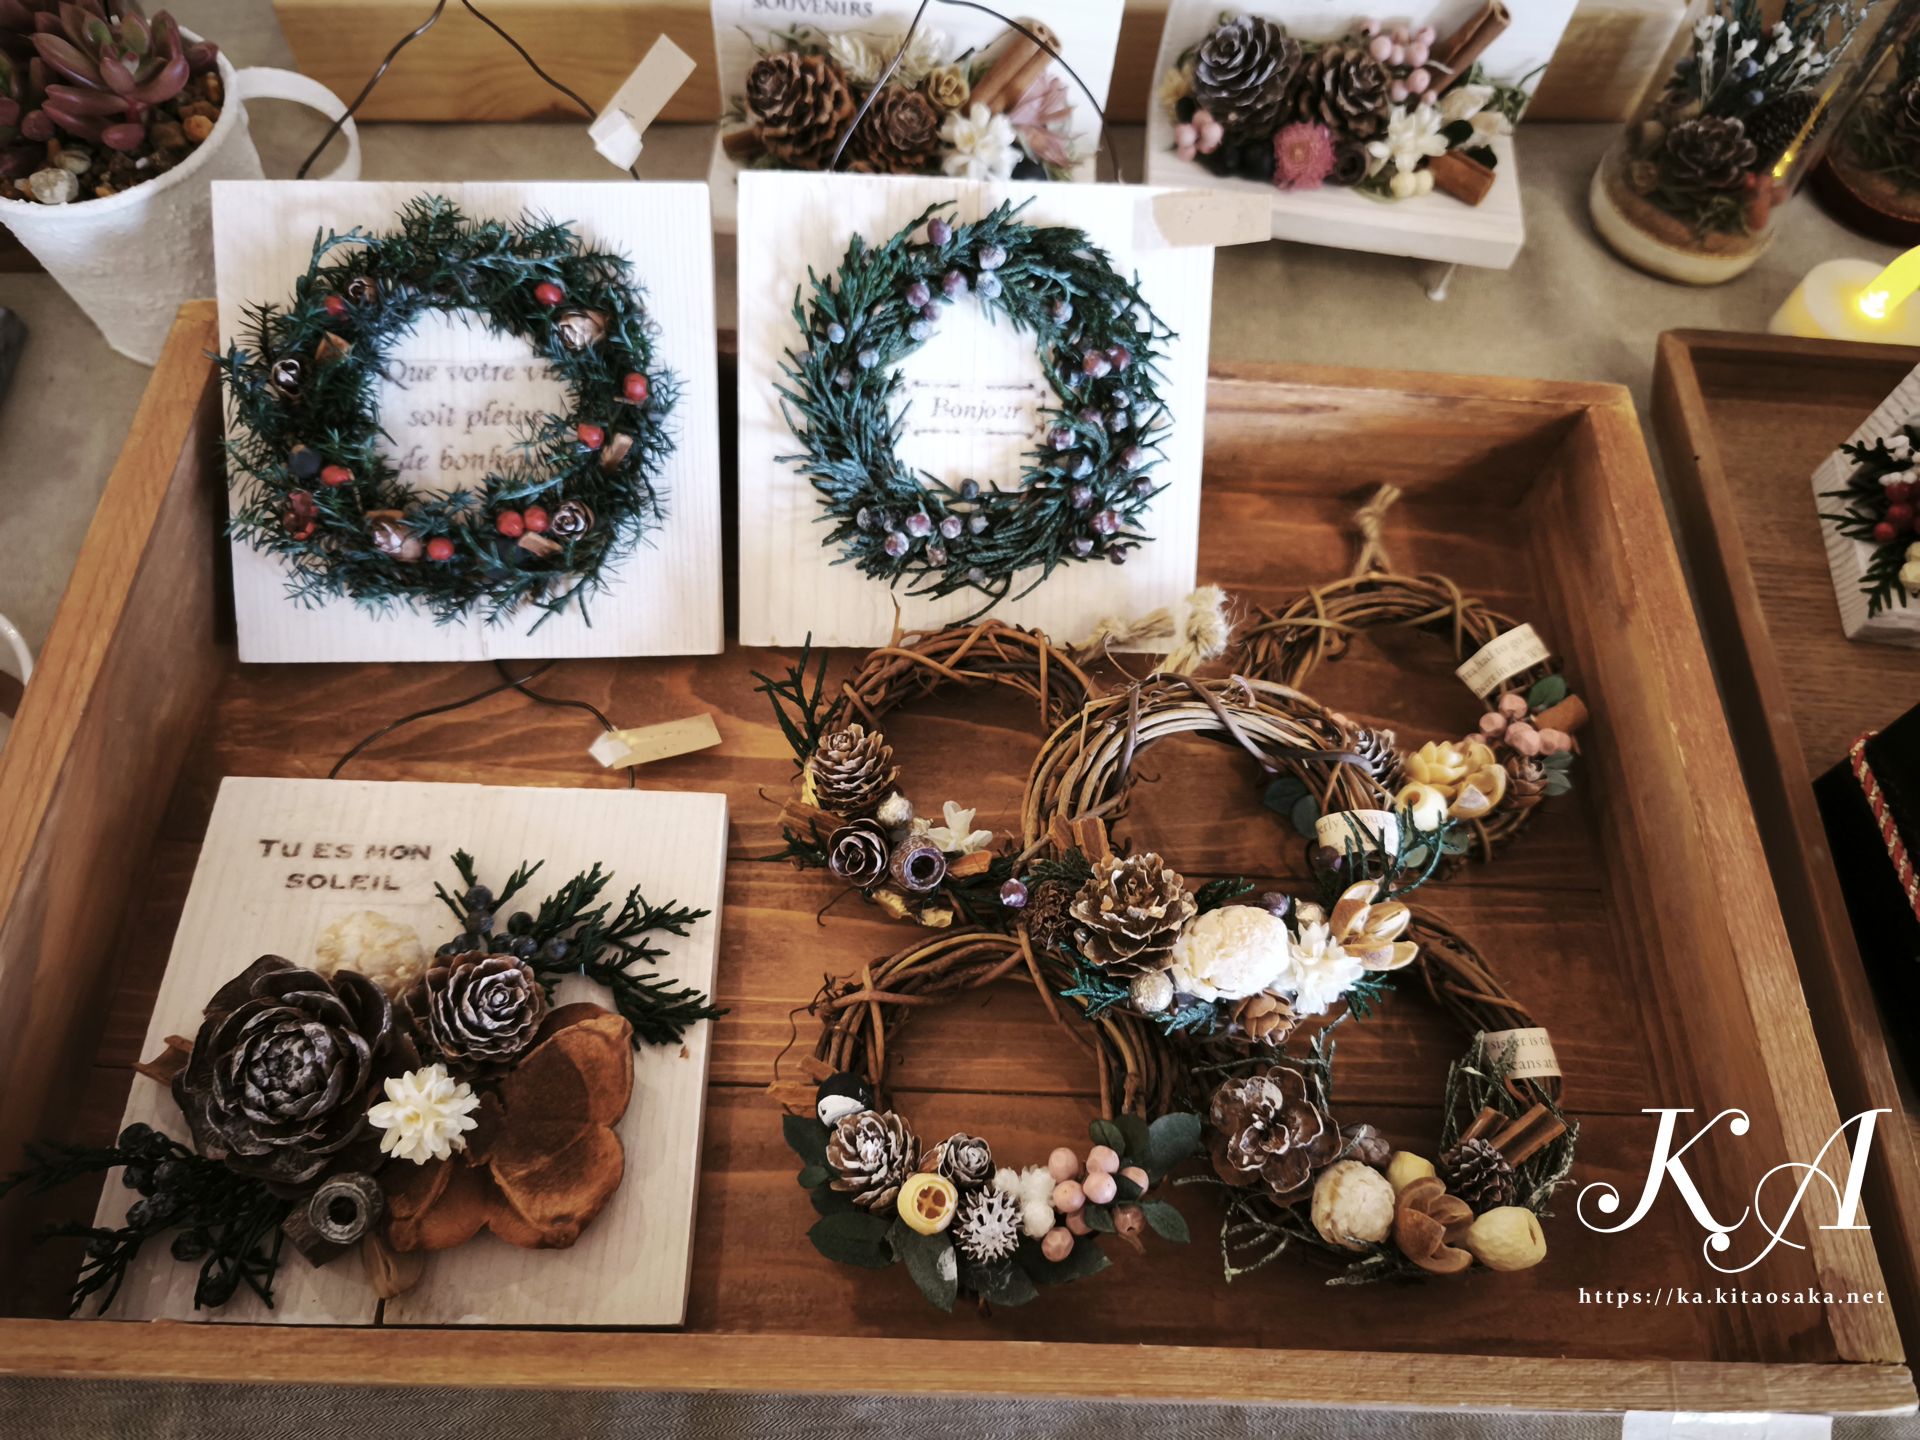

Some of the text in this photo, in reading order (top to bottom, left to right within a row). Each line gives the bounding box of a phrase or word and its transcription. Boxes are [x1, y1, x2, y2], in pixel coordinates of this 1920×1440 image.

[386, 359, 437, 390] Que
[447, 363, 515, 382] votre
[407, 399, 544, 435] soit pleine
[930, 396, 1022, 423] Bonjour
[400, 445, 429, 471] de
[1494, 644, 1508, 655] to
[1509, 637, 1522, 651] go
[1494, 665, 1508, 677] in
[1508, 656, 1527, 670] the
[258, 839, 432, 861] TU ES MON
[284, 872, 401, 891] SOLEIL
[1528, 1033, 1538, 1046] is
